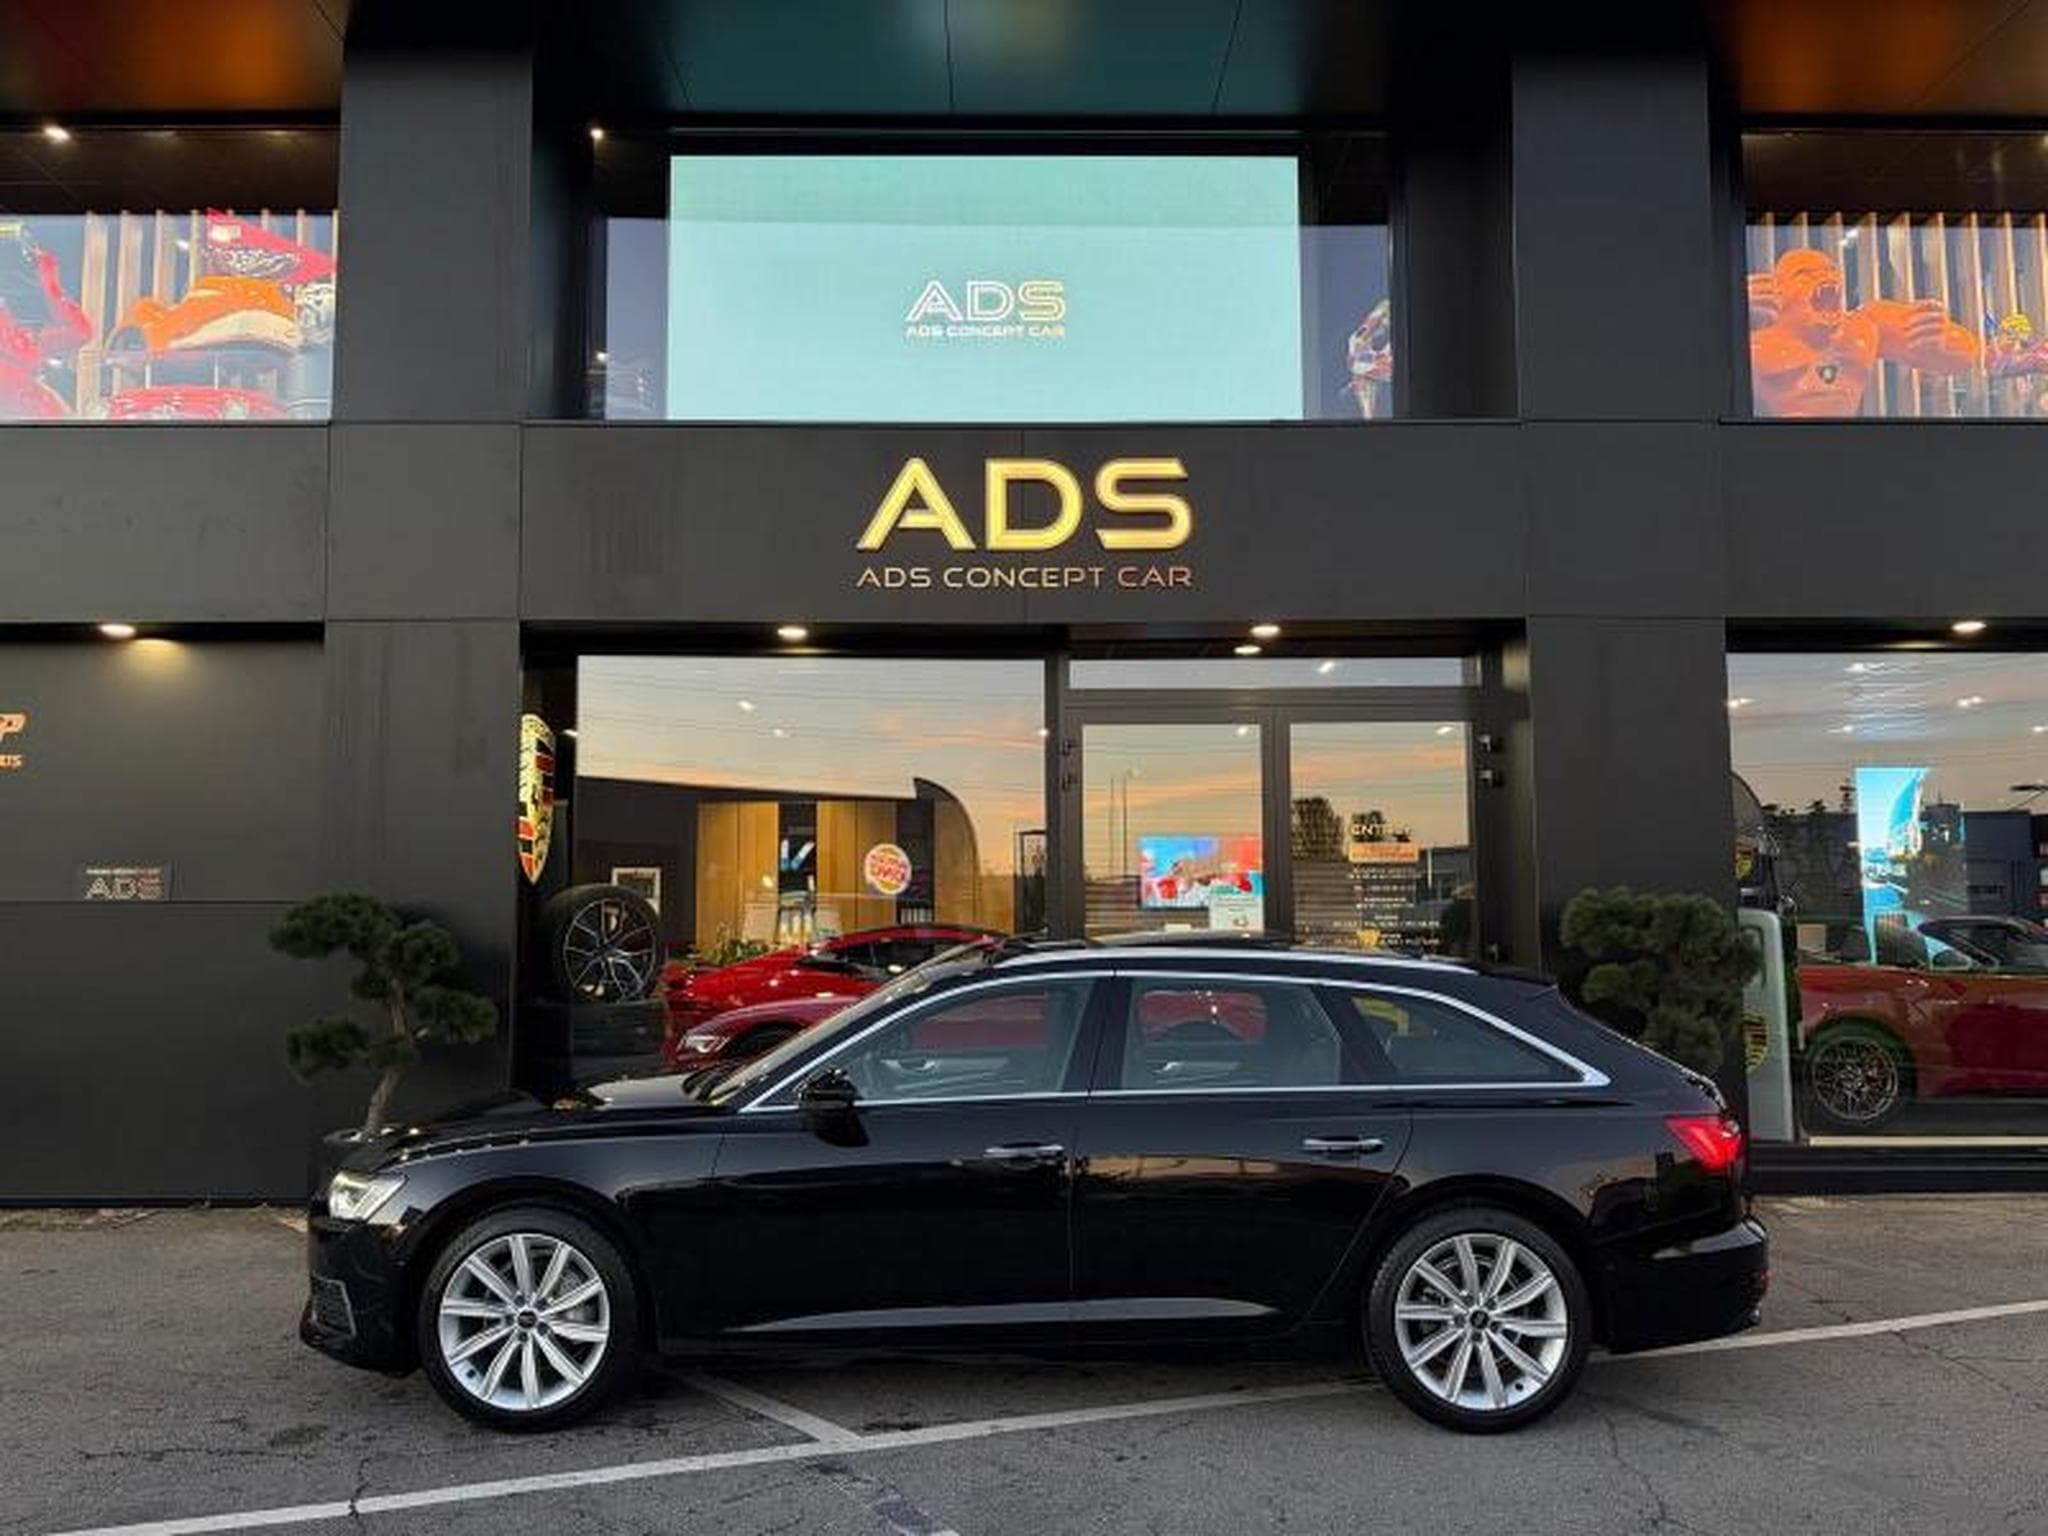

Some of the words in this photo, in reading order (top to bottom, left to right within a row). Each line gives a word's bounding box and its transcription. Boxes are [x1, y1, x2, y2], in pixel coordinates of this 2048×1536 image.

[905, 279, 1067, 322] ADS
[905, 325, 943, 338] ADS
[946, 325, 1024, 338] CONCEPT
[1028, 325, 1066, 338] CAR
[855, 457, 1192, 551] ADS
[856, 566, 932, 589] ADS
[942, 566, 1104, 589] CONCEPT
[1116, 566, 1193, 589] CAR
[84, 877, 161, 900] ADS
